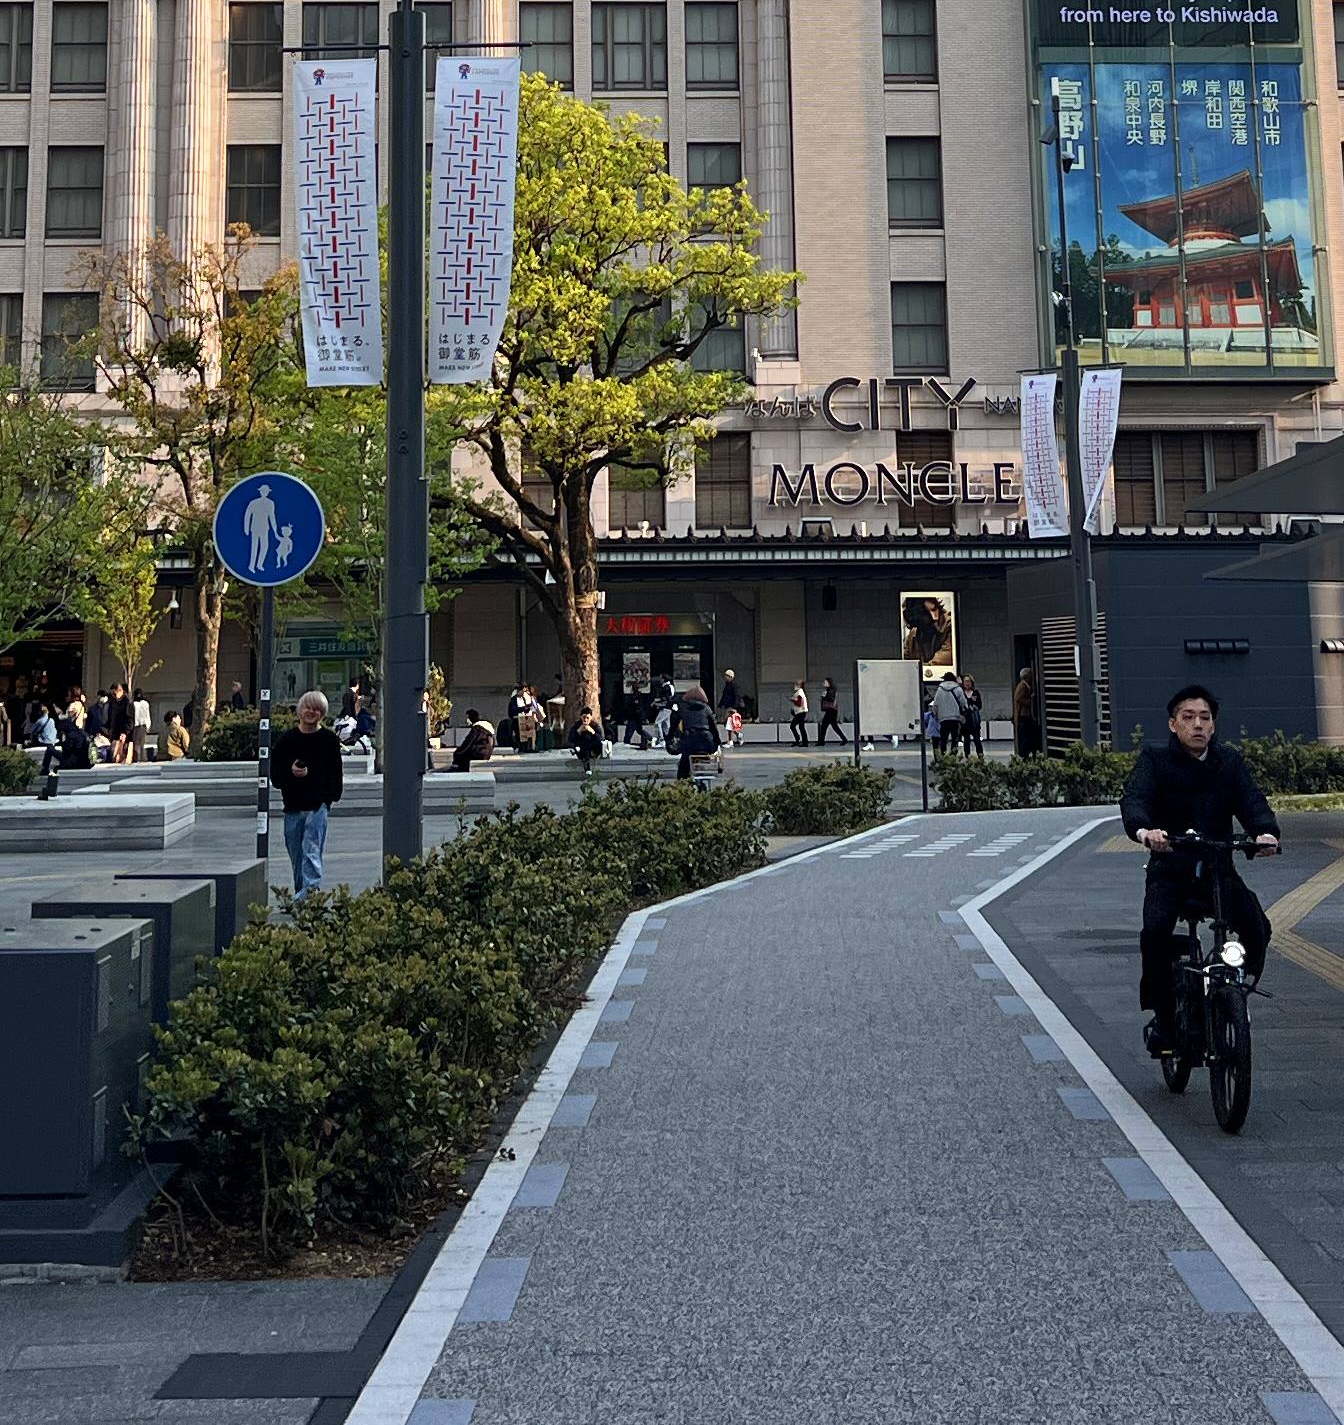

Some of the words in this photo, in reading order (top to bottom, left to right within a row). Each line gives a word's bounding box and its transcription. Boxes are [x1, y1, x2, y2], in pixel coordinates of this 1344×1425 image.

[1059, 7, 1104, 23] from
[1109, 7, 1151, 23] here
[1155, 8, 1176, 23] to
[1181, 6, 1278, 23] Kishiwada
[1123, 80, 1144, 146] 和泉中央
[1147, 80, 1167, 146] 河内長野
[1181, 79, 1199, 96] 堺
[1205, 79, 1223, 129] 岸和田
[1228, 79, 1248, 145] 関西空港
[1260, 80, 1281, 146] 和歌山市
[744, 395, 818, 419] なんば
[820, 375, 978, 433] CITY
[768, 460, 1023, 508] MONCLE
